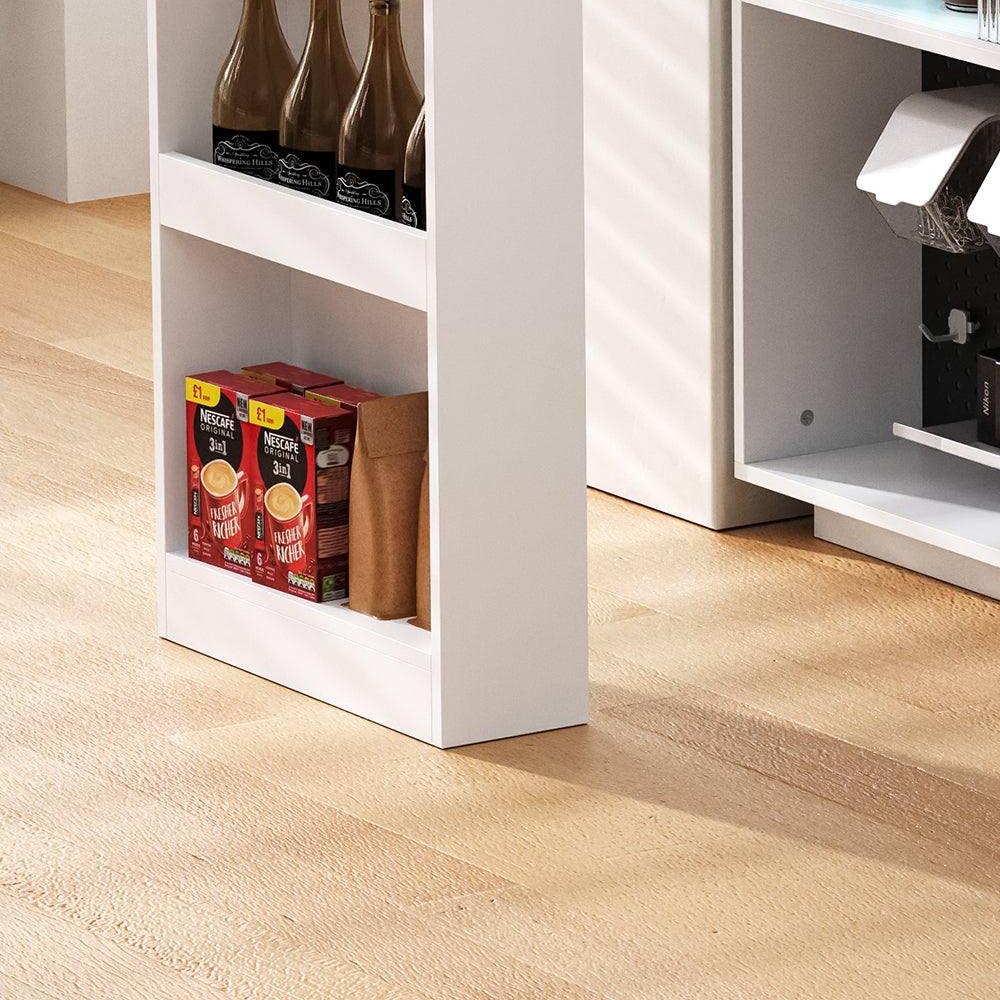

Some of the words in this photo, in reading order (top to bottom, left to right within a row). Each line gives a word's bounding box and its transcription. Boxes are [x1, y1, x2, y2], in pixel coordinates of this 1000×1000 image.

[200, 423, 234, 440] ORIGINAL
[264, 446, 299, 463] ORIGINAL
[193, 529, 199, 541] 6
[256, 552, 262, 565] 6
